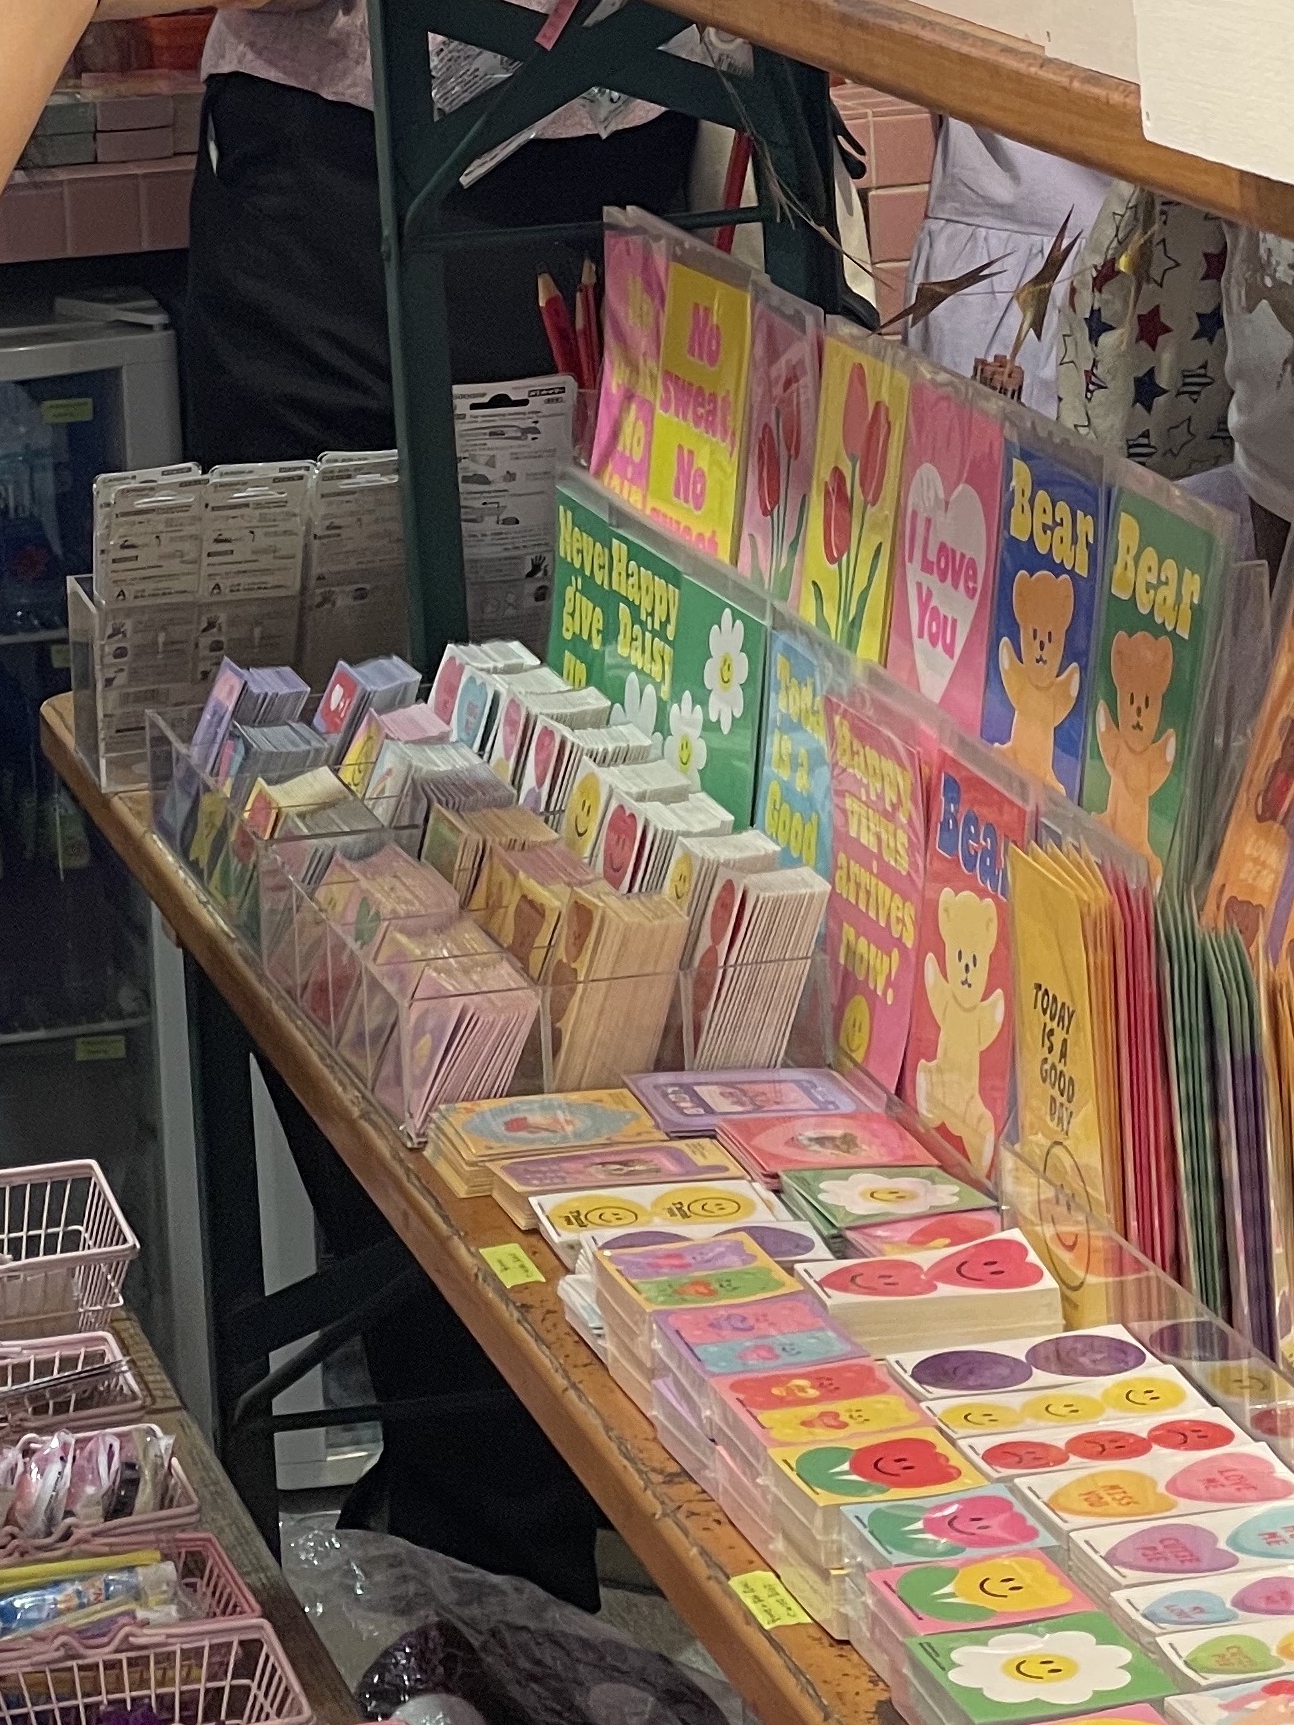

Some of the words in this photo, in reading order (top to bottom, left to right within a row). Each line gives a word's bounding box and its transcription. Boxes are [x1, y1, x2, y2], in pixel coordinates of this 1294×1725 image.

[687, 303, 721, 368] No
[673, 444, 706, 512] No
[1010, 457, 1095, 578] Bear
[611, 537, 680, 641] Happy
[920, 536, 978, 601] Love
[1111, 511, 1201, 640] Bear
[617, 602, 674, 701] Daisy
[915, 582, 959, 660] You
[1033, 982, 1076, 1035] TODAY
[1041, 1022, 1055, 1055] IS
[1058, 1037, 1068, 1067] A
[1039, 1057, 1075, 1104] GOOD
[1049, 1094, 1074, 1137] DAY
